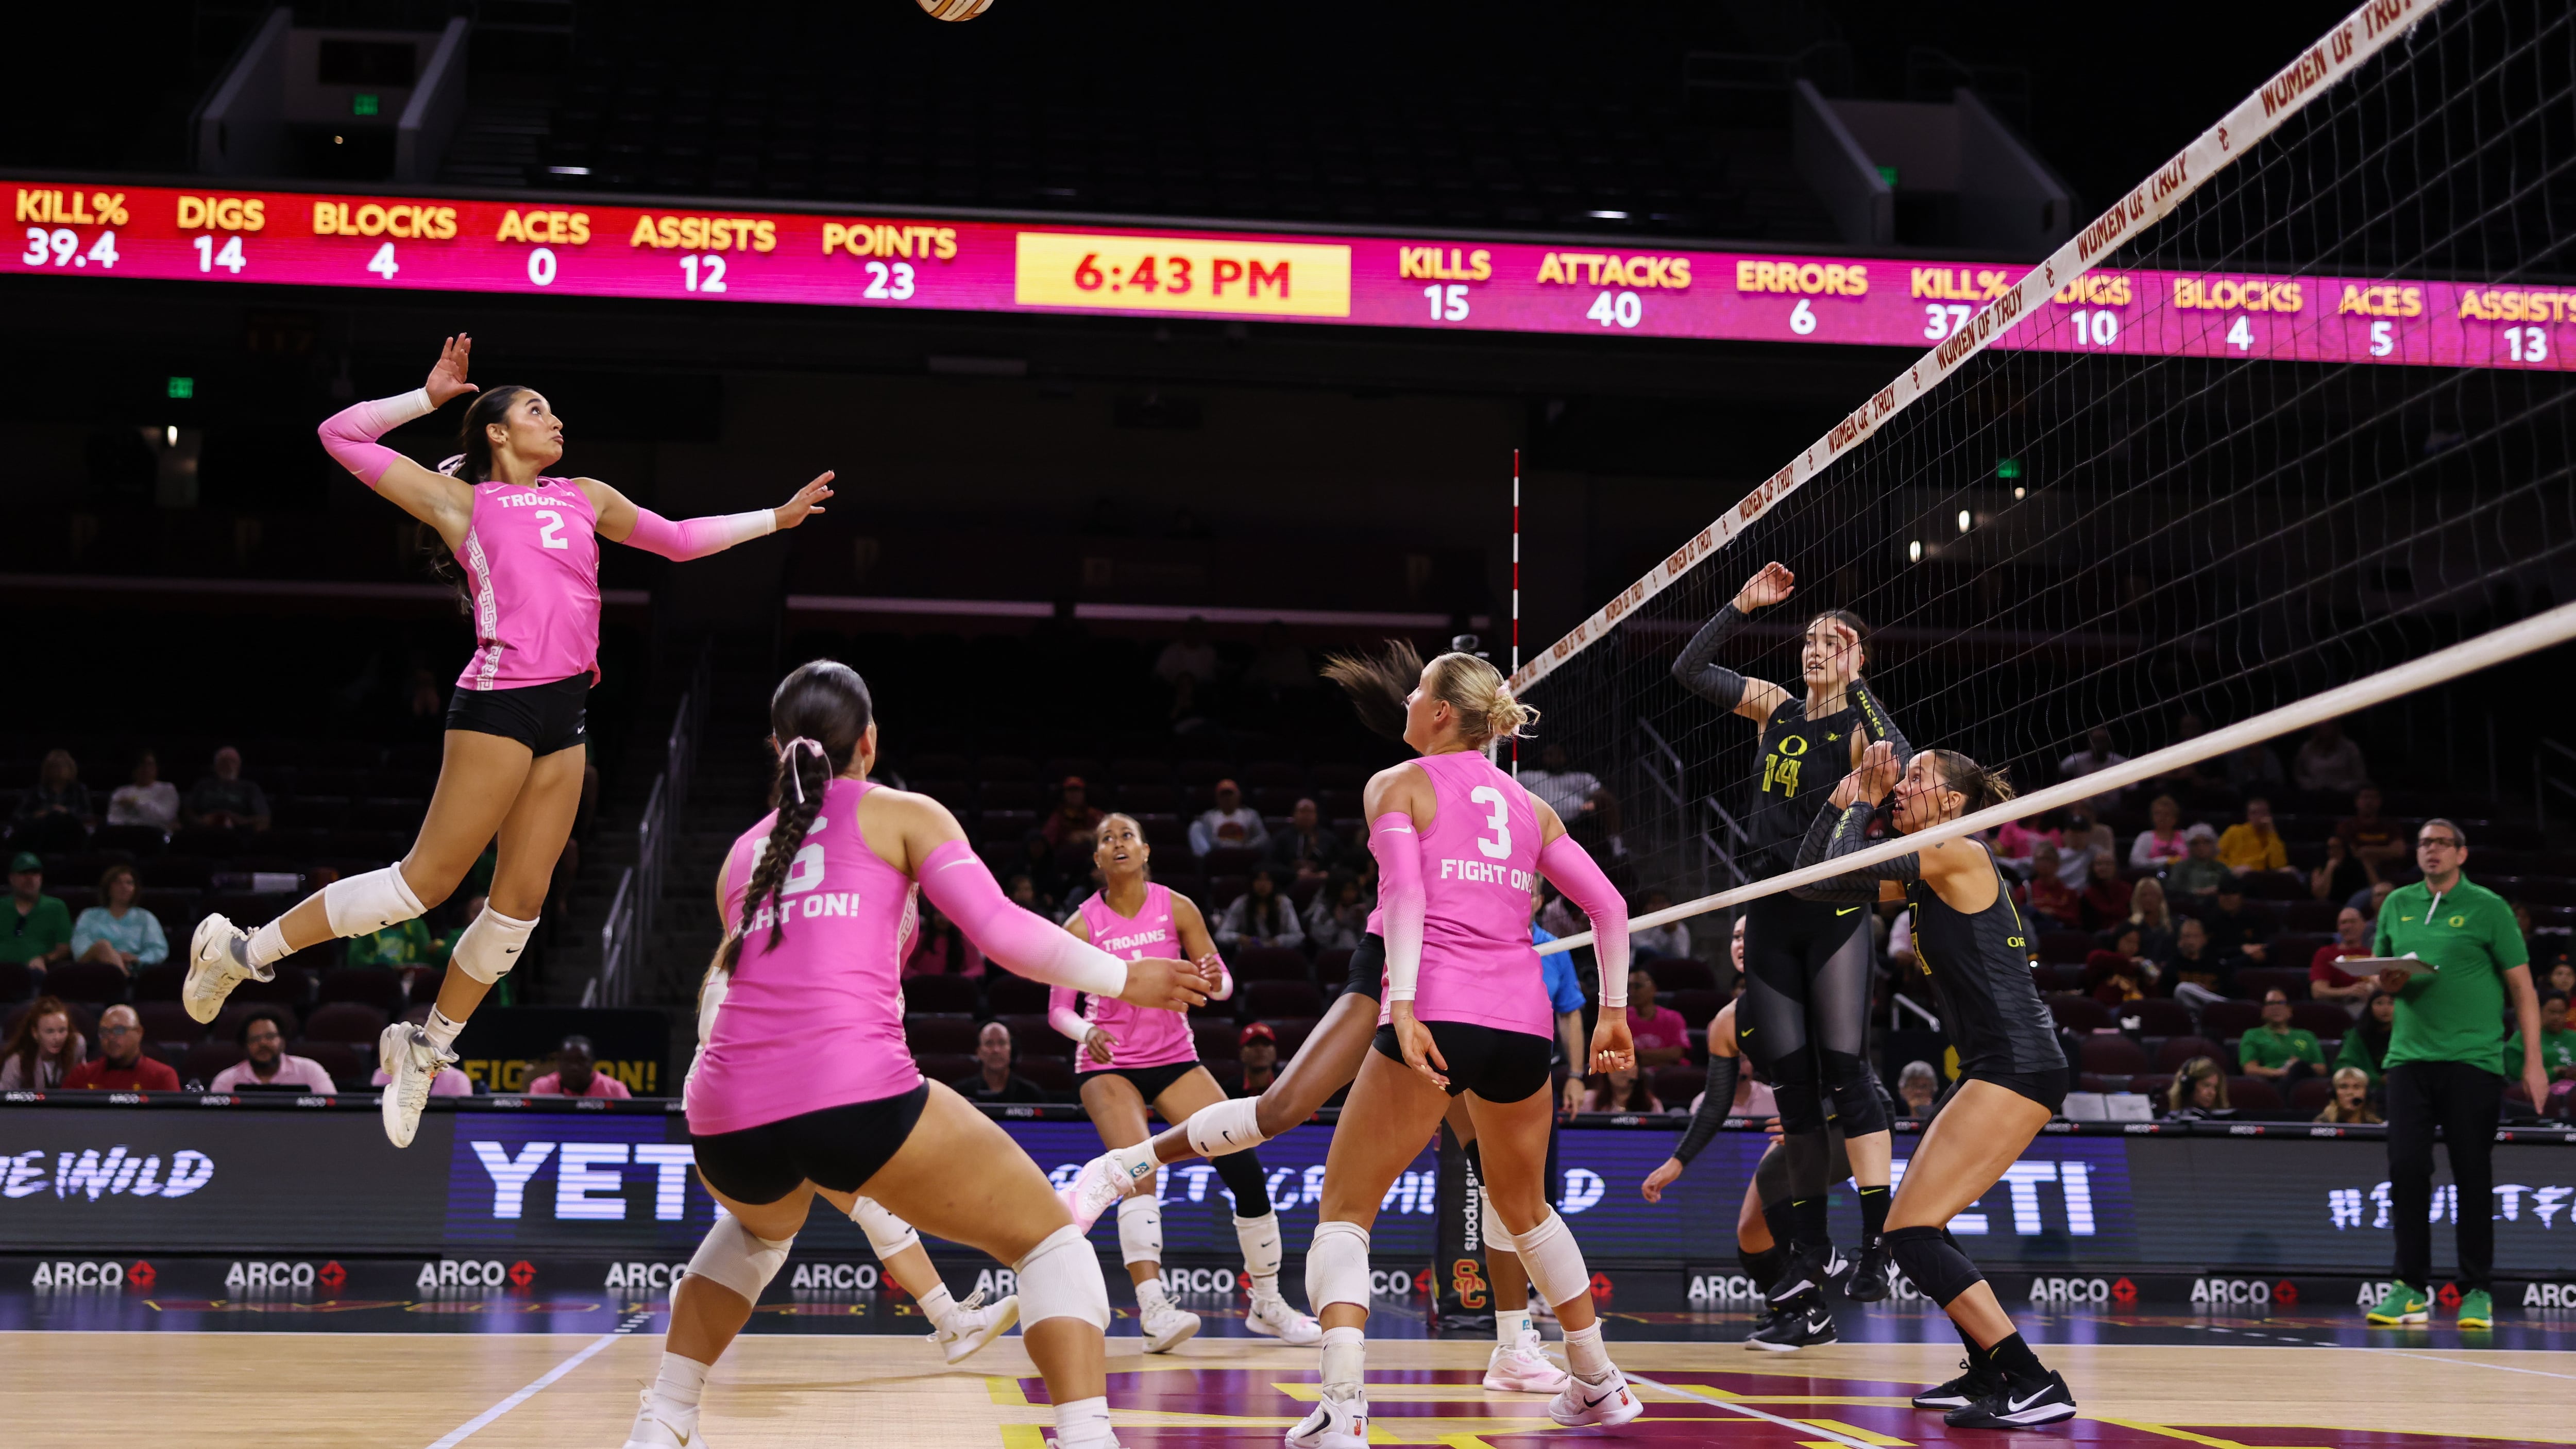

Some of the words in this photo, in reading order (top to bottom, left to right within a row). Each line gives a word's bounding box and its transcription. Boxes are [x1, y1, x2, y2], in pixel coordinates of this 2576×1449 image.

[2260, 46, 2327, 117] WOMEN
[2331, 22, 2354, 64] OF
[16, 189, 129, 225] KILL%
[177, 195, 265, 231] DIGS
[313, 201, 457, 240] BLOCKS
[2077, 201, 2127, 263] WOMEN
[2128, 183, 2145, 221] OF
[2149, 151, 2187, 203] TROY
[496, 210, 591, 245] ACES
[630, 215, 776, 252] ASSISTS
[822, 223, 957, 259] POINTS
[22, 227, 120, 268] 39.4
[193, 235, 247, 273] 14
[366, 242, 399, 280] 4
[1399, 246, 1493, 281] KILLS
[527, 247, 557, 287] 0
[679, 255, 727, 293] 12
[862, 261, 916, 300] 23
[1074, 253, 1193, 294] 6:43
[1212, 259, 1291, 299] PM
[1537, 252, 1692, 289] ATTACKS
[1736, 260, 1869, 296] ERRORS
[1910, 267, 2011, 301] KILL%
[1423, 284, 1470, 321] 15
[2053, 274, 2134, 306] DIGS
[2174, 277, 2303, 312] BLOCKS
[2338, 284, 2422, 317] ACES
[1586, 291, 1642, 328] 40
[1789, 298, 1817, 335] 6
[1936, 321, 1976, 371] WOMEN
[1977, 310, 1990, 341] OF
[1994, 282, 2023, 328] TROY
[2071, 310, 2119, 346] 10
[2225, 315, 2255, 351] 4
[2369, 321, 2394, 357] 5
[2503, 326, 2548, 362] 13
[1827, 415, 1858, 456] WOMEN
[1858, 402, 1869, 430] OF
[1872, 382, 1895, 420] TROY
[497, 492, 577, 508] TROJ
[1738, 486, 1765, 523] WOMEN
[1764, 477, 1774, 503] OF
[1775, 462, 1794, 495] TROY
[535, 510, 568, 549] 2
[1856, 689, 1886, 737] DUCKS
[1762, 753, 1802, 798] 14
[1471, 785, 1512, 861] 3
[1440, 859, 1506, 885] FIGHT
[1511, 869, 1534, 895] ON!
[803, 893, 860, 918] ON!
[1102, 929, 1166, 952] TROJANS
[471, 1141, 731, 1221] YET
[1462, 1189, 1479, 1252] imports
[31, 1261, 124, 1287] ARCO
[225, 1261, 315, 1287] ARCO
[416, 1260, 505, 1287] ARCO
[790, 1263, 878, 1290] ARCO
[975, 1269, 1018, 1293] AR
[1370, 1270, 1412, 1296] CO
[2028, 1277, 2110, 1302] ARCO
[2190, 1279, 2270, 1304] ARCO
[2522, 1283, 2576, 1308] ARC
